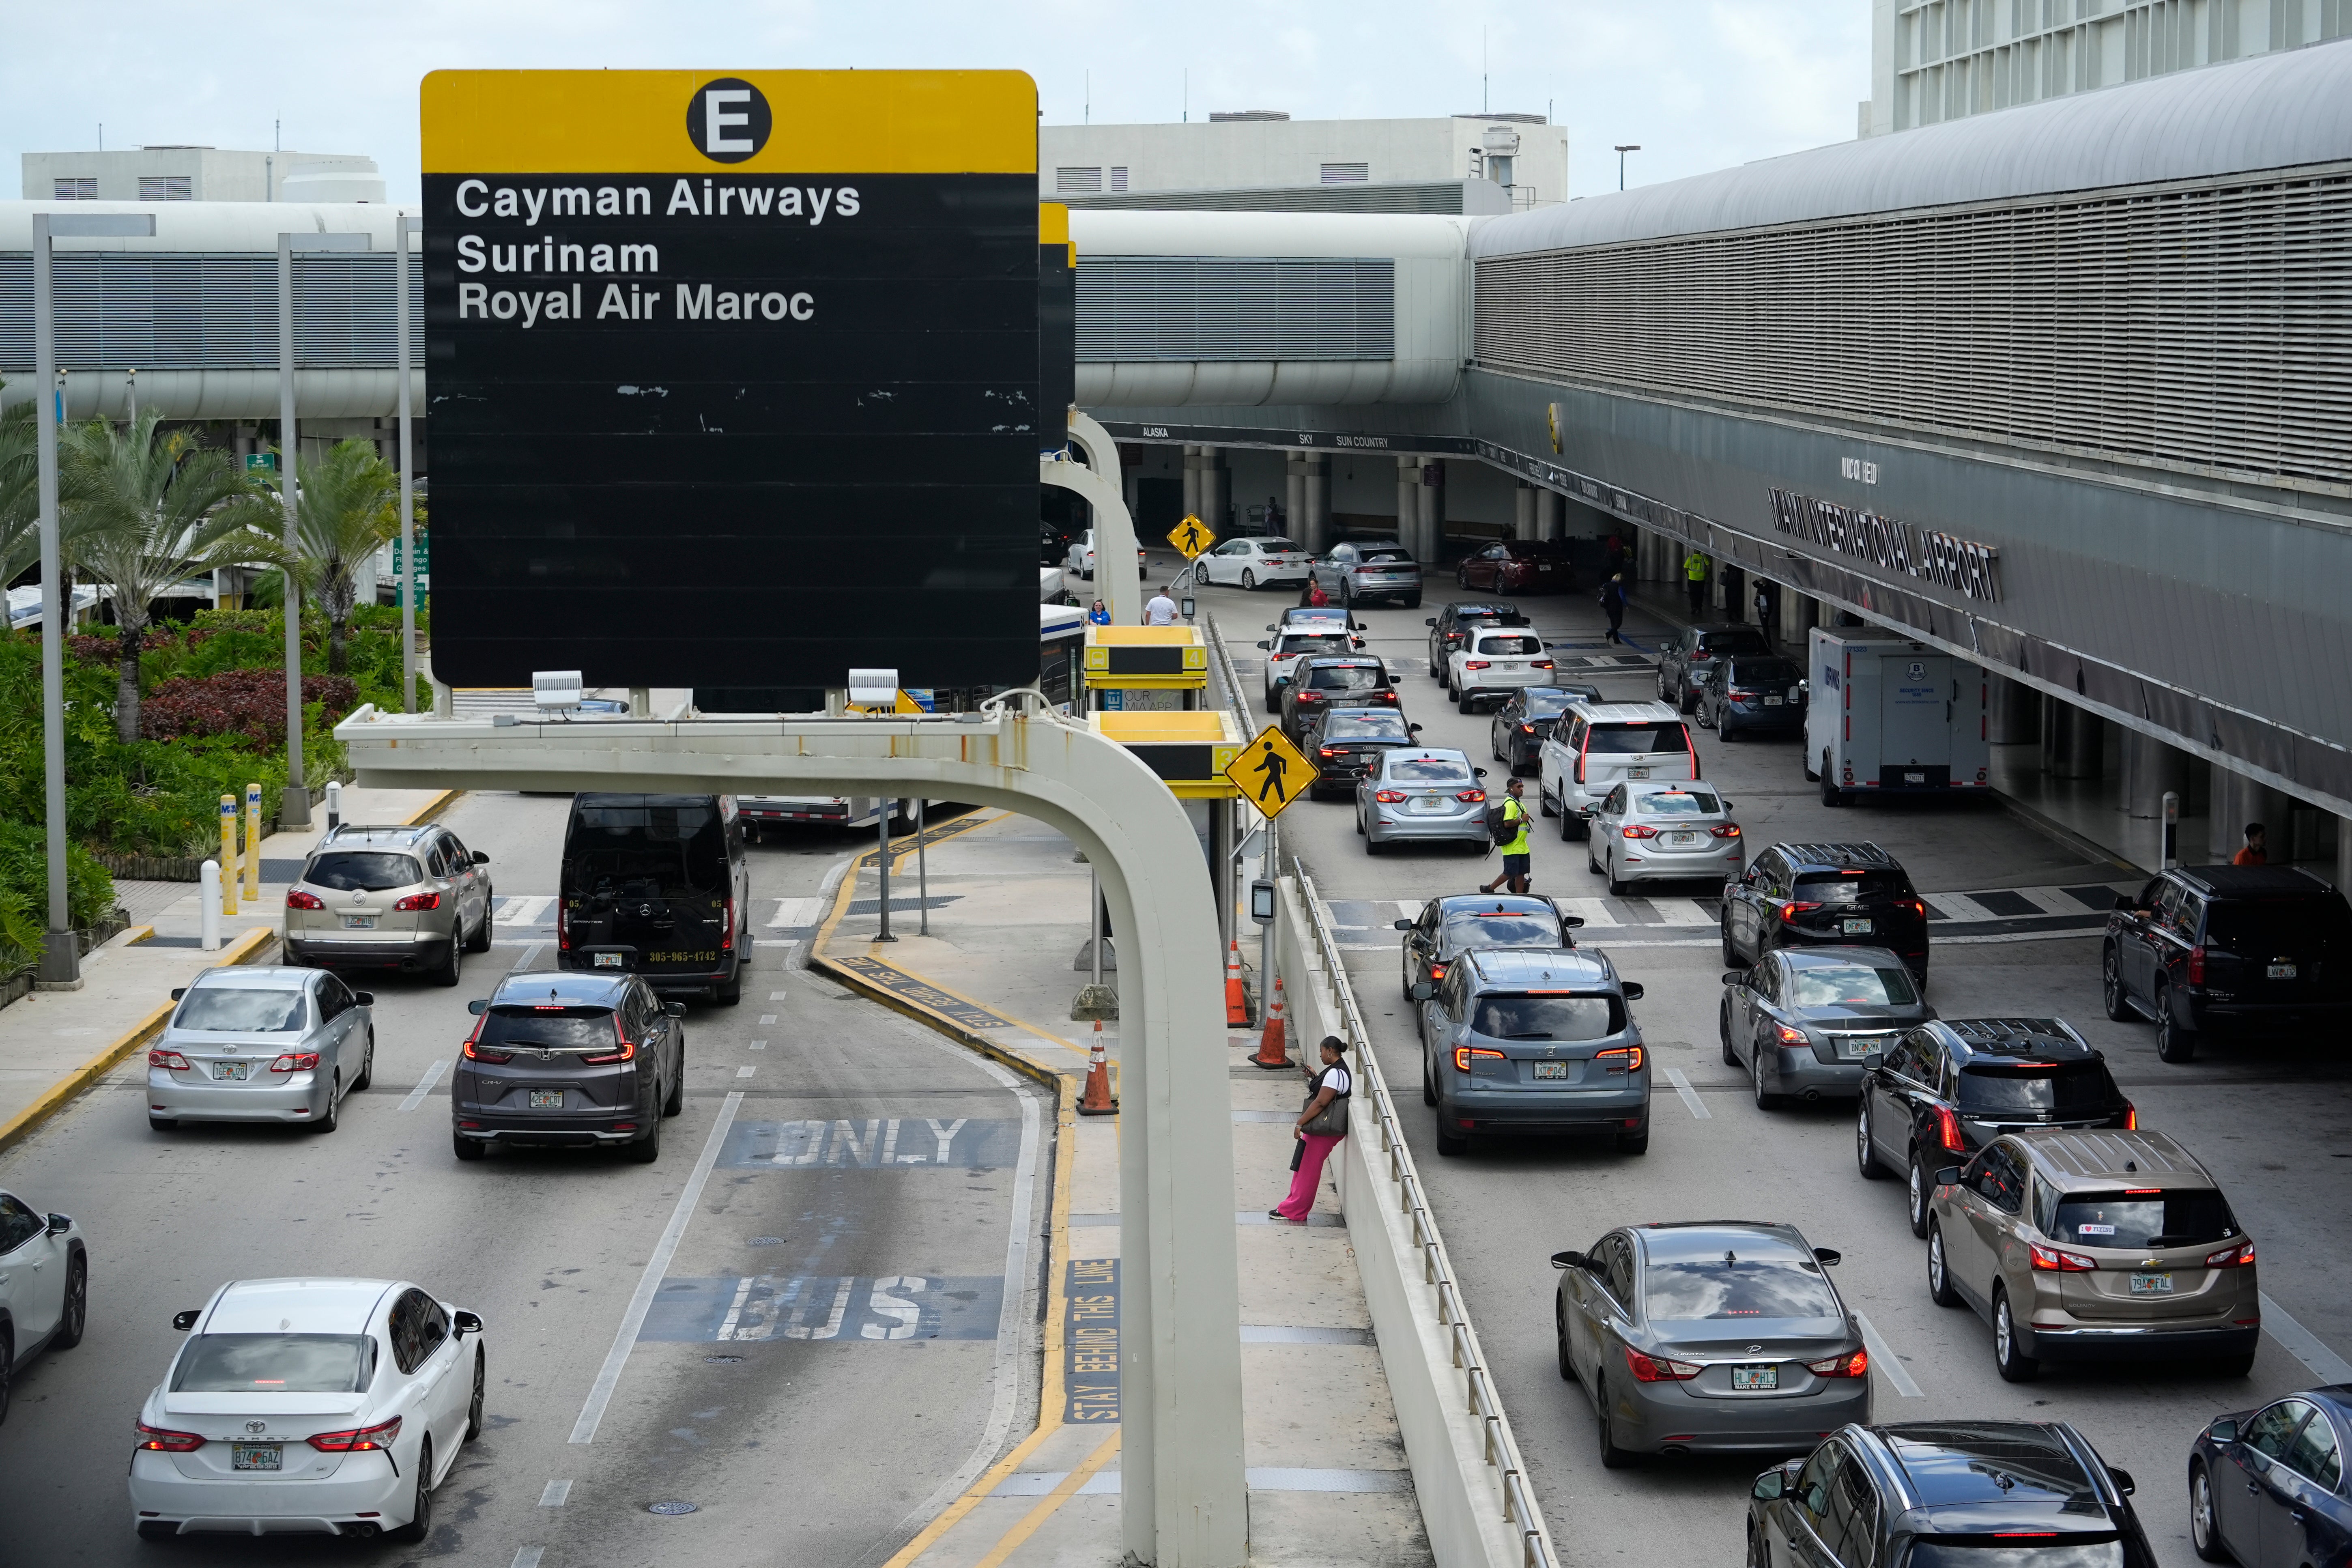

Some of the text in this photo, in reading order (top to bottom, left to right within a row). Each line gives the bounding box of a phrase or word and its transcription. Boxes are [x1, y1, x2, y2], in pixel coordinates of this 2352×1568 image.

[706, 90, 753, 153] E
[456, 179, 860, 226] Cayman Airways
[457, 234, 658, 273] Surinam
[459, 283, 814, 329] Royal Air Maroc
[1144, 427, 1169, 437] ALASKA
[1299, 434, 1313, 444] SKY
[1336, 436, 1388, 448] SUN COUNTRY
[1767, 488, 1997, 603] MIAMI INTERNATIONAL AIRPORT
[1080, 615, 1085, 630] 64
[1189, 651, 1199, 665] 4
[1125, 690, 1150, 701] OUR
[1125, 703, 1172, 711] MIA APP
[1221, 750, 1234, 768] 3
[569, 900, 579, 908] 05
[712, 900, 722, 908] 05
[649, 951, 716, 962] 305-965-4742
[836, 957, 1004, 1028] STAY BEHIND THIS LINE
[215, 1067, 227, 1075] 16E
[1535, 1067, 1565, 1075] LKD D45
[531, 1095, 561, 1104] 42E CBT
[771, 1118, 969, 1164] ONLY
[2132, 1278, 2170, 1289] 79A FAL
[716, 1276, 927, 1341] BUS
[1073, 1259, 1119, 1420] STAY BEHIND THIS LINE
[1735, 1372, 1776, 1384] HLJ H13
[235, 1451, 279, 1463] 874 6AZ
